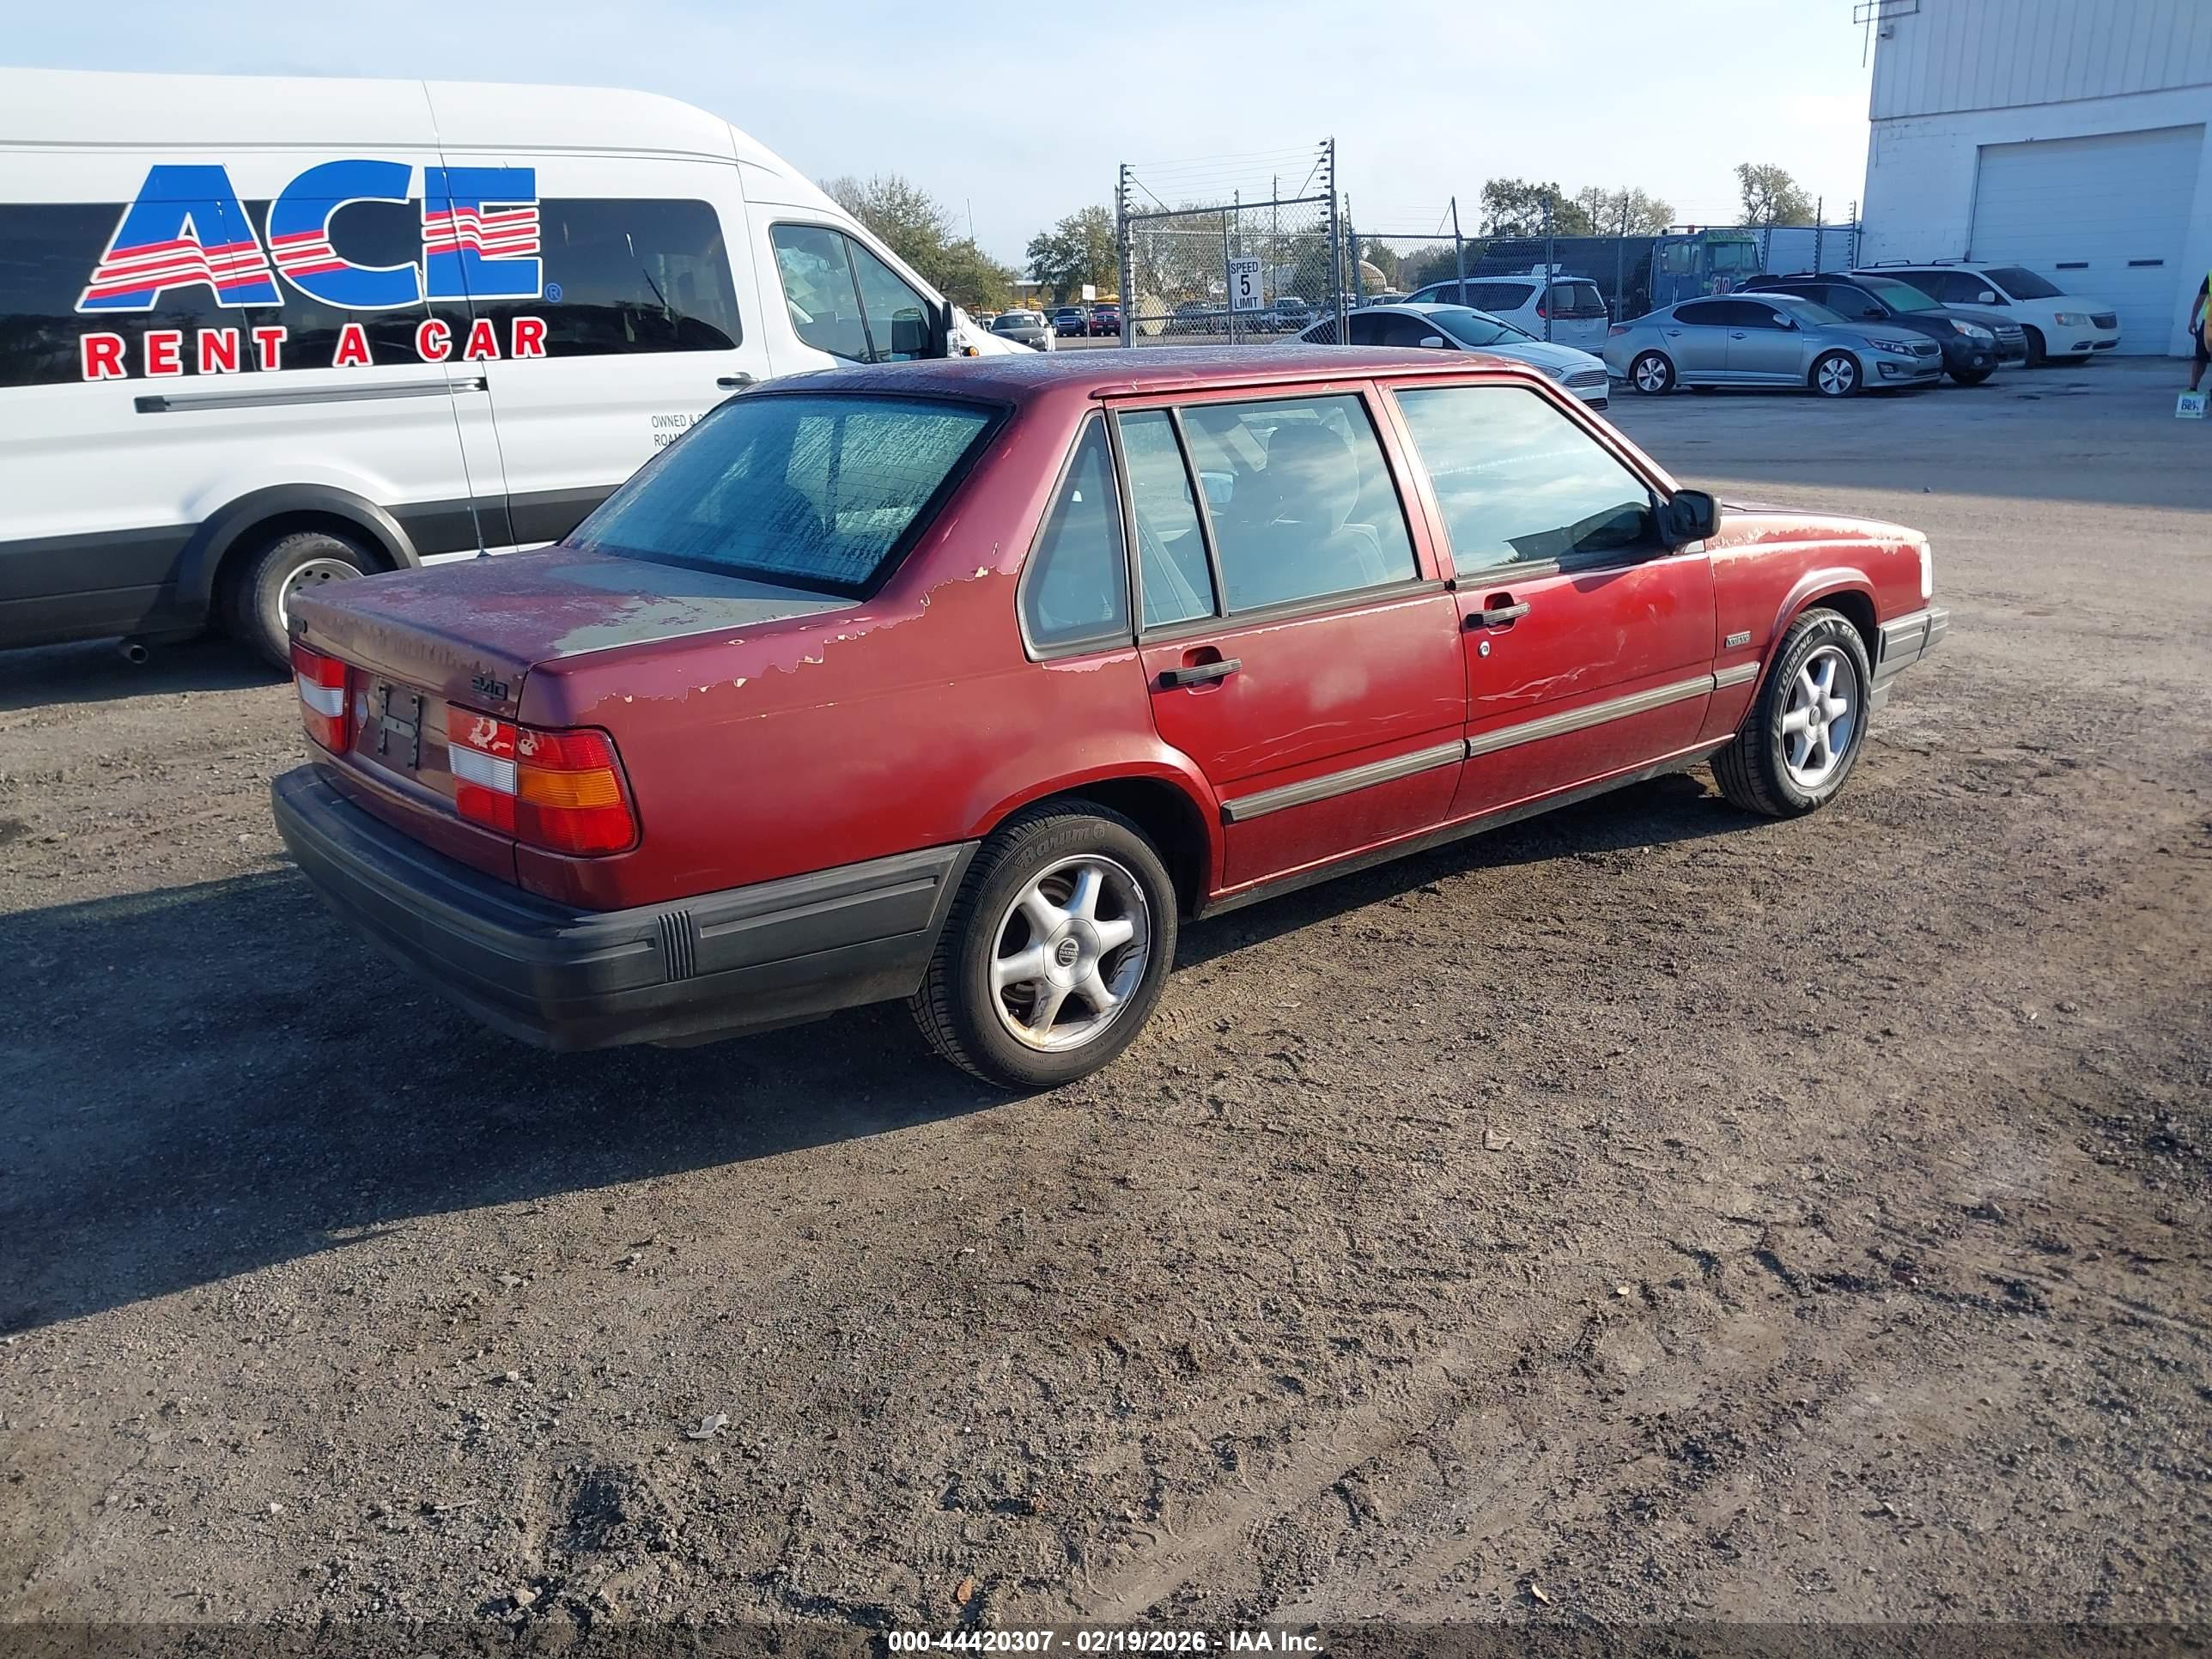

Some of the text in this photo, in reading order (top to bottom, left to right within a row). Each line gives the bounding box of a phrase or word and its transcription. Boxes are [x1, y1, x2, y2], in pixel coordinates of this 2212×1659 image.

[75, 160, 543, 312] ACE
[1231, 261, 1258, 274] SPEED
[1241, 275, 1251, 295] 5
[1234, 296, 1258, 309] LIMIT
[81, 317, 547, 381] RENT A CAR
[651, 414, 687, 428] OWNED
[1778, 632, 1814, 695] TOURING
[1020, 827, 1090, 866] Barum
